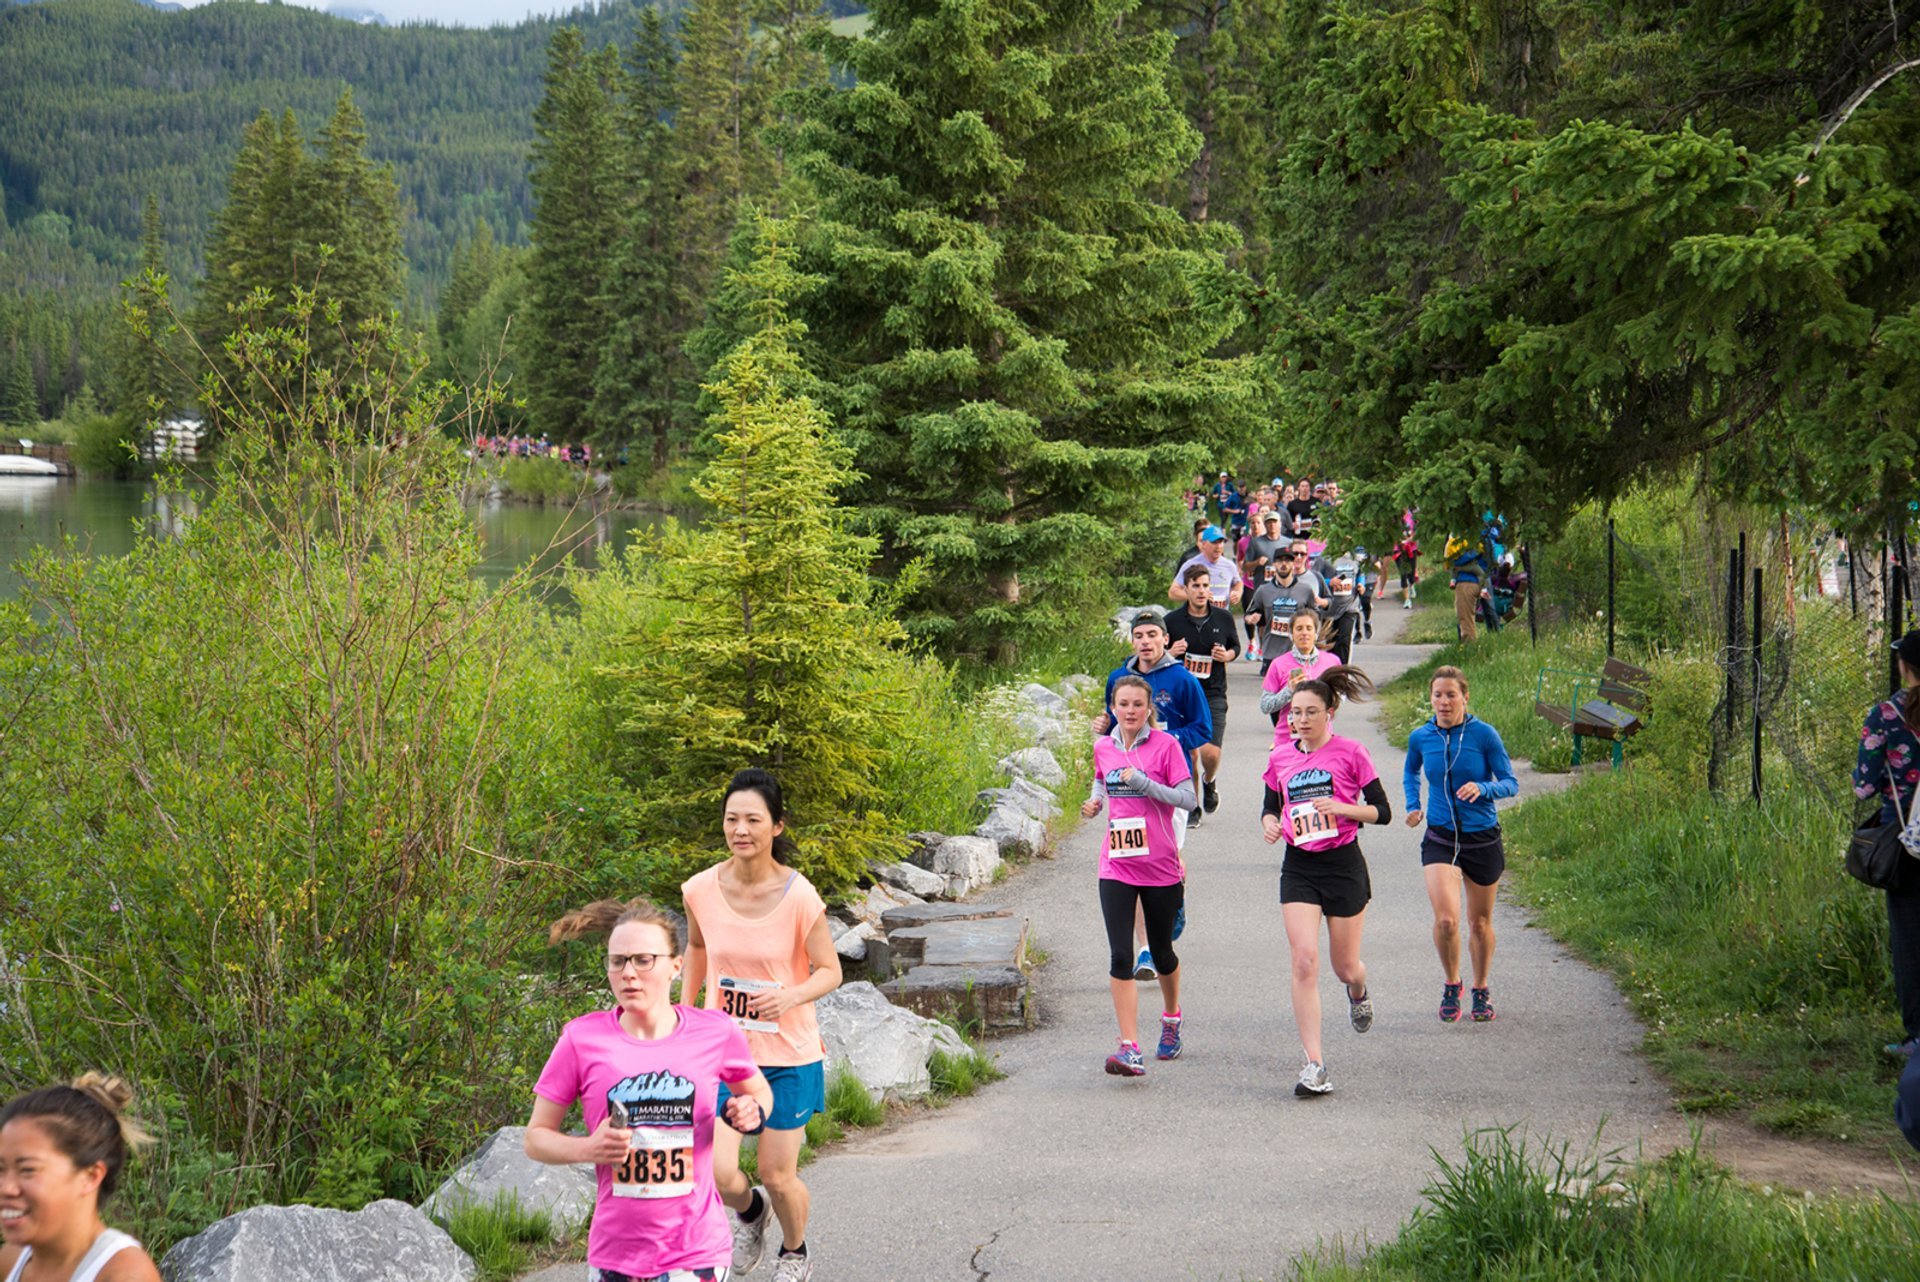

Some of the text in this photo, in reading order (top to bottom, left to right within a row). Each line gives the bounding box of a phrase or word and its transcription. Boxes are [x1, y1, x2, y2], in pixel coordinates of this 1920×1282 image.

[1273, 621, 1289, 633] 329
[1294, 812, 1331, 837] 3141
[1110, 829, 1144, 850] 3140
[722, 989, 760, 1020] 30
[617, 1148, 685, 1184] 3835
